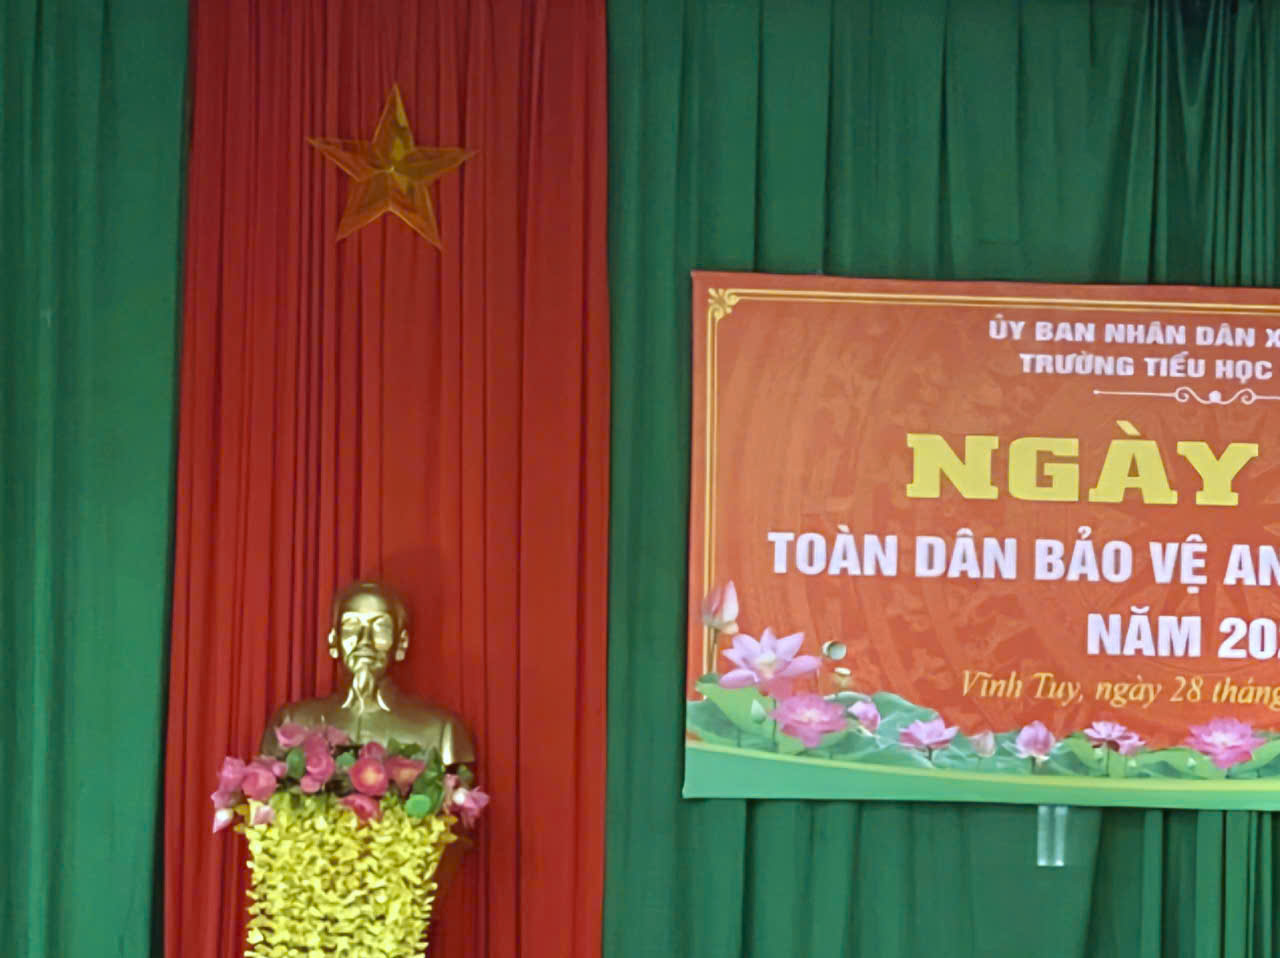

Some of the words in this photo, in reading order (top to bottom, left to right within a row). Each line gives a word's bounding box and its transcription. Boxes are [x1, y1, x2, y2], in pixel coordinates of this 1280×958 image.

[1035, 321, 1095, 343] BAN
[1104, 321, 1186, 345] NHÂN
[1196, 322, 1256, 347] DÂN
[1019, 350, 1134, 376] TRƯỜNG
[1215, 359, 1273, 384] HỌC
[906, 420, 1259, 506] NGÀY
[768, 524, 898, 577] TOÀN
[915, 528, 1017, 580] DÂN
[1034, 526, 1133, 582] BẢO
[1149, 534, 1208, 594] VỆ
[1087, 605, 1202, 657] NĂM
[962, 669, 1023, 698] Vĩnh
[1032, 672, 1084, 707] Tuy,
[1095, 674, 1162, 709] ngày
[1170, 675, 1204, 703] 28
